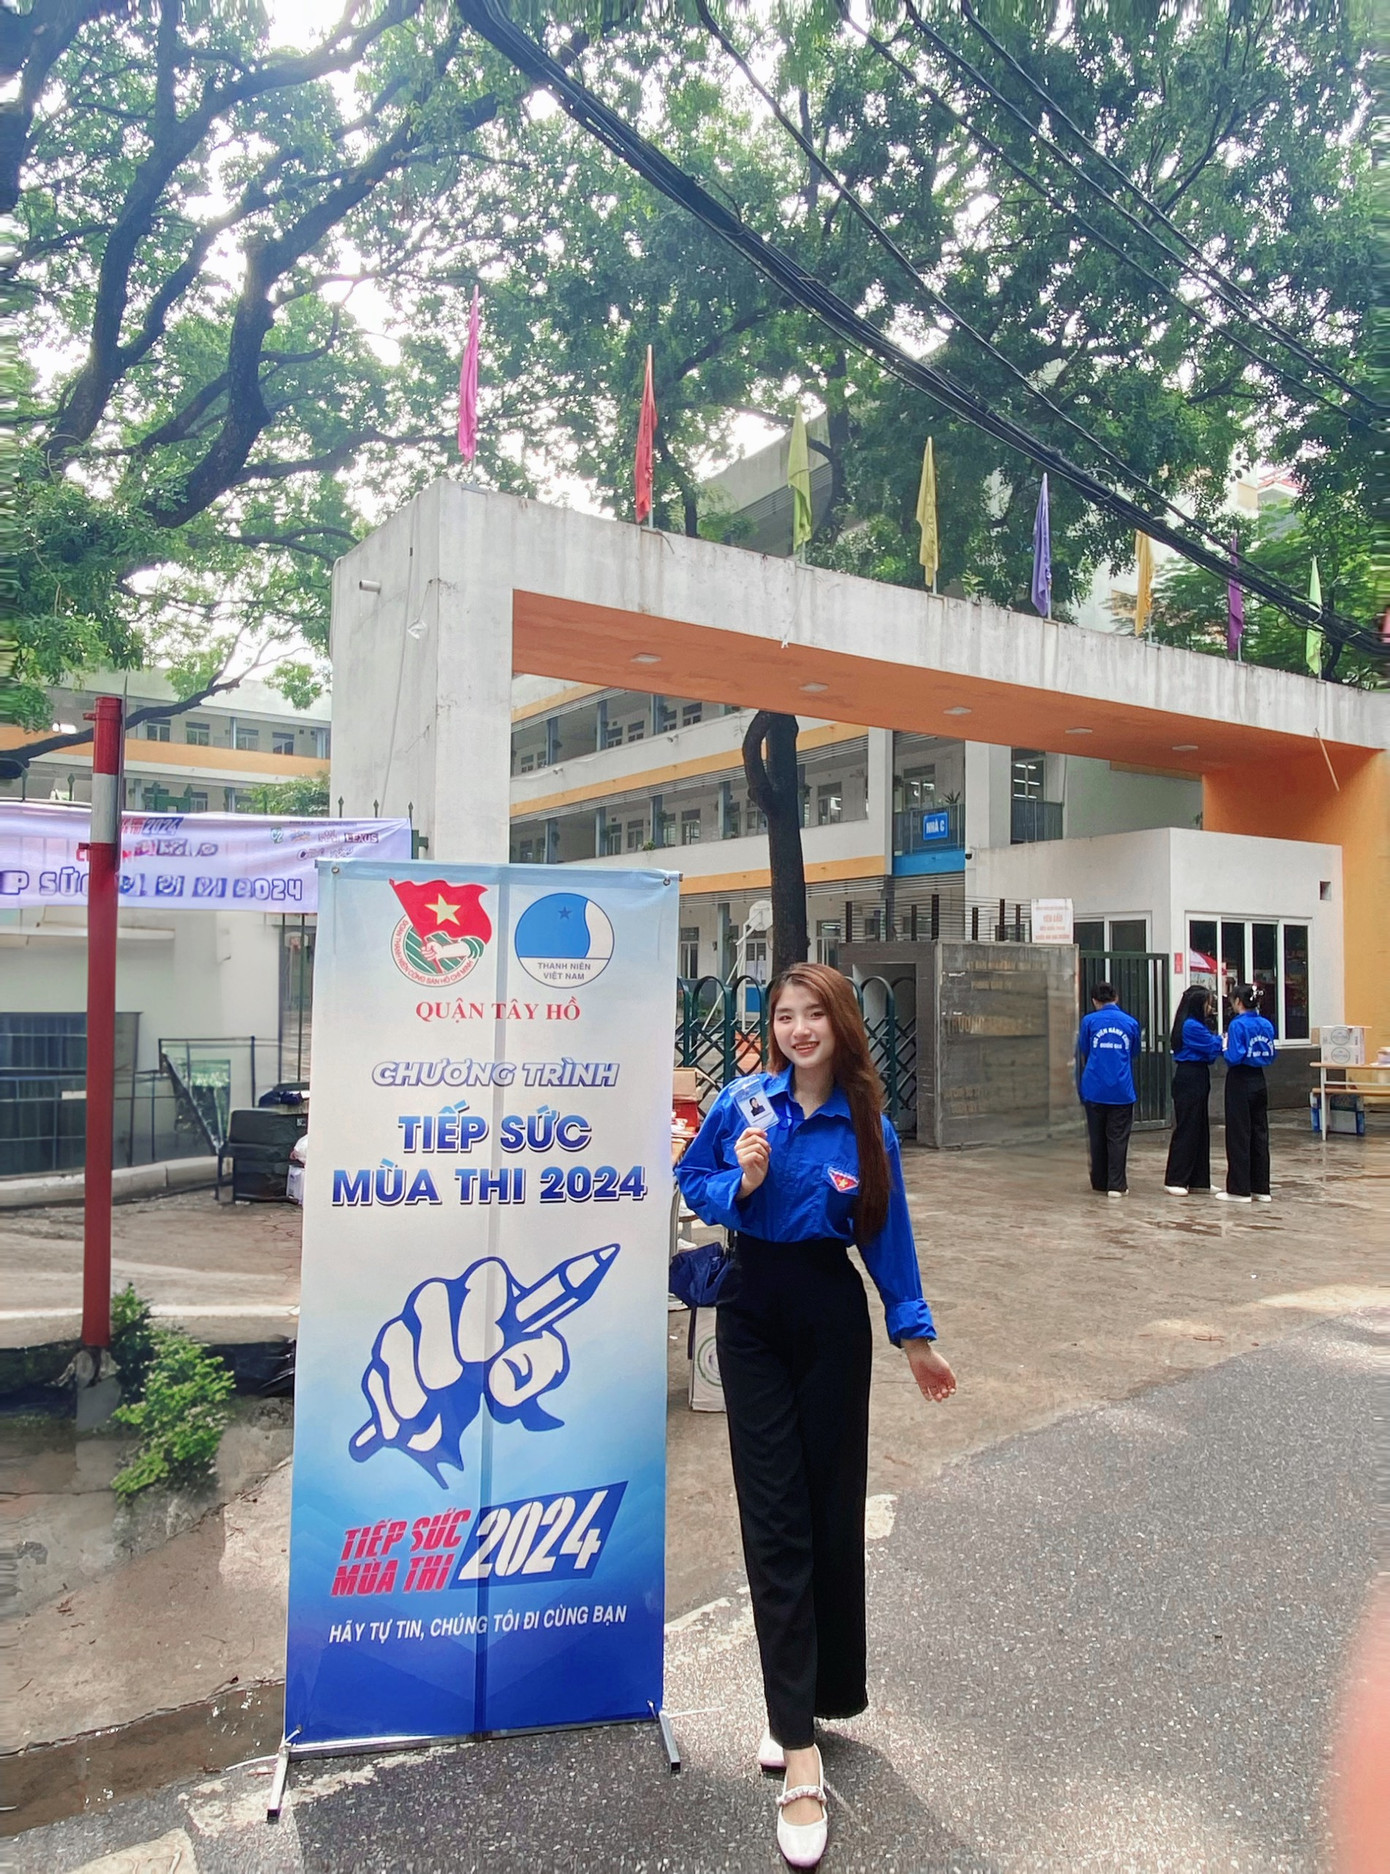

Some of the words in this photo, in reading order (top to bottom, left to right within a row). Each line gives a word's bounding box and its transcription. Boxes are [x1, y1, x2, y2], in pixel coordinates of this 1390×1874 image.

[538, 962, 568, 970] THANH
[570, 961, 591, 971] NIÊN
[543, 971, 563, 981] VIỆT
[565, 972, 585, 980] NAM
[416, 997, 484, 1023] QUẬN
[491, 998, 540, 1020] TÂY
[546, 995, 581, 1021] HỒ
[372, 1058, 517, 1087] CHƯƠNG
[522, 1057, 621, 1087] TRÌNH
[398, 1100, 490, 1153] TIẾP
[499, 1104, 592, 1153] SỨC
[332, 1158, 442, 1206] MÙA
[454, 1167, 526, 1205] THI
[539, 1165, 648, 1203] 2024
[339, 1518, 408, 1562] TIẾP
[409, 1507, 472, 1553] SỨC
[457, 1489, 610, 1582] 2024
[330, 1557, 398, 1598] MÙA
[402, 1553, 455, 1594] THI
[329, 1621, 365, 1643] HÃY
[369, 1619, 393, 1645] TỰ
[396, 1619, 425, 1641] TIN,
[430, 1612, 487, 1637] CHÚNG
[493, 1610, 519, 1634] TÔI
[523, 1611, 540, 1632] ĐI
[543, 1604, 589, 1628] CÙNG
[592, 1604, 627, 1625] BẠN
